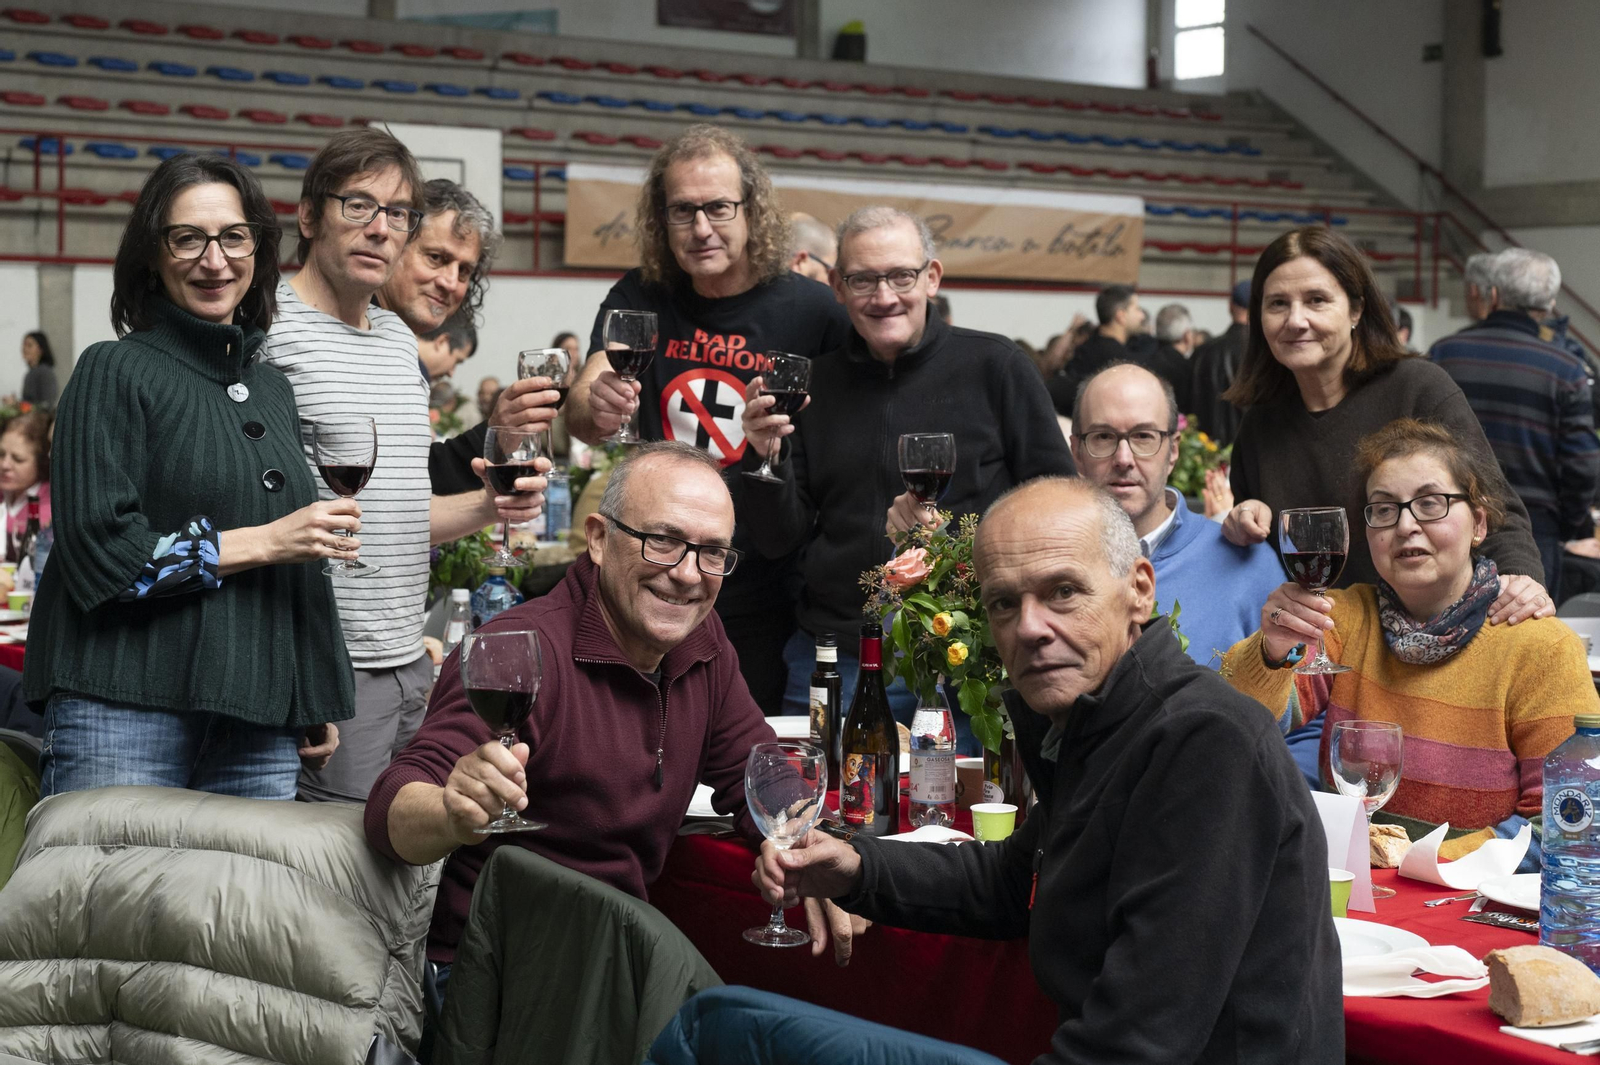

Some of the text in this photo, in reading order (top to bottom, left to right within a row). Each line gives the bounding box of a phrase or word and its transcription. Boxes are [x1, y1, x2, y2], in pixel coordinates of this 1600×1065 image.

[694, 328, 746, 350] BAD
[665, 339, 774, 372] RELIGION
[1553, 790, 1592, 818] MONDARIZ
